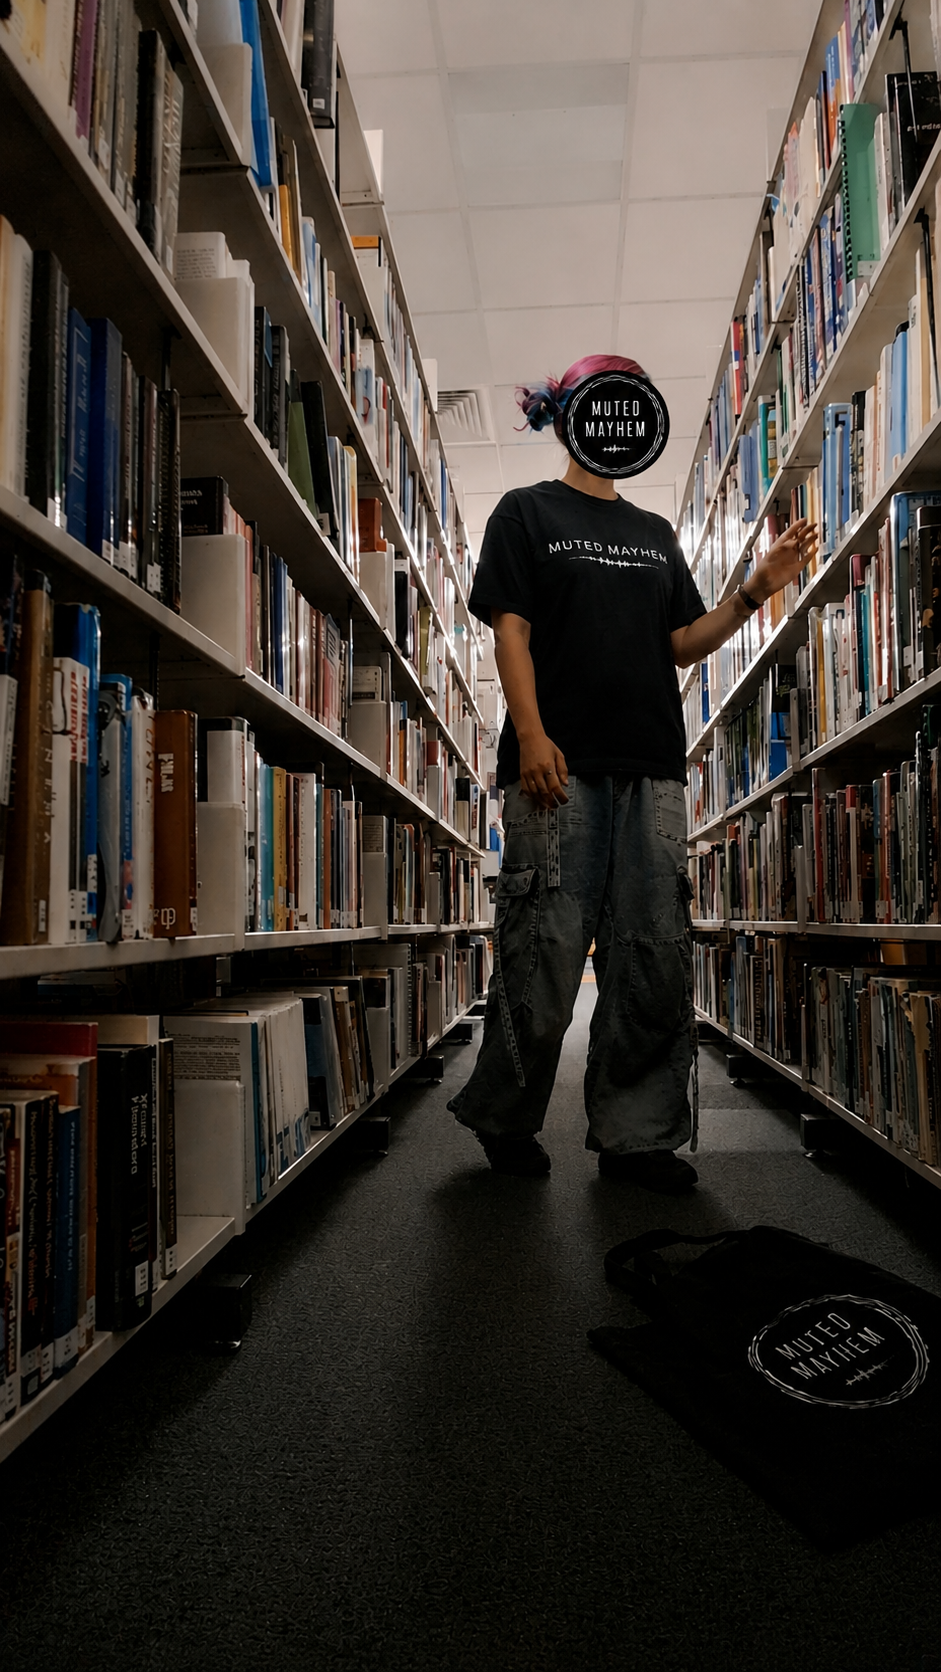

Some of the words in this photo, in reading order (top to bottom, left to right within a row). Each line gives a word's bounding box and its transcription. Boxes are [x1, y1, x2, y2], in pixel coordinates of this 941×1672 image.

[548, 539, 603, 554] MUTED
[607, 544, 668, 564] MAYHEM
[775, 1312, 851, 1360] MUTED
[790, 1326, 885, 1380] MAYHEM
